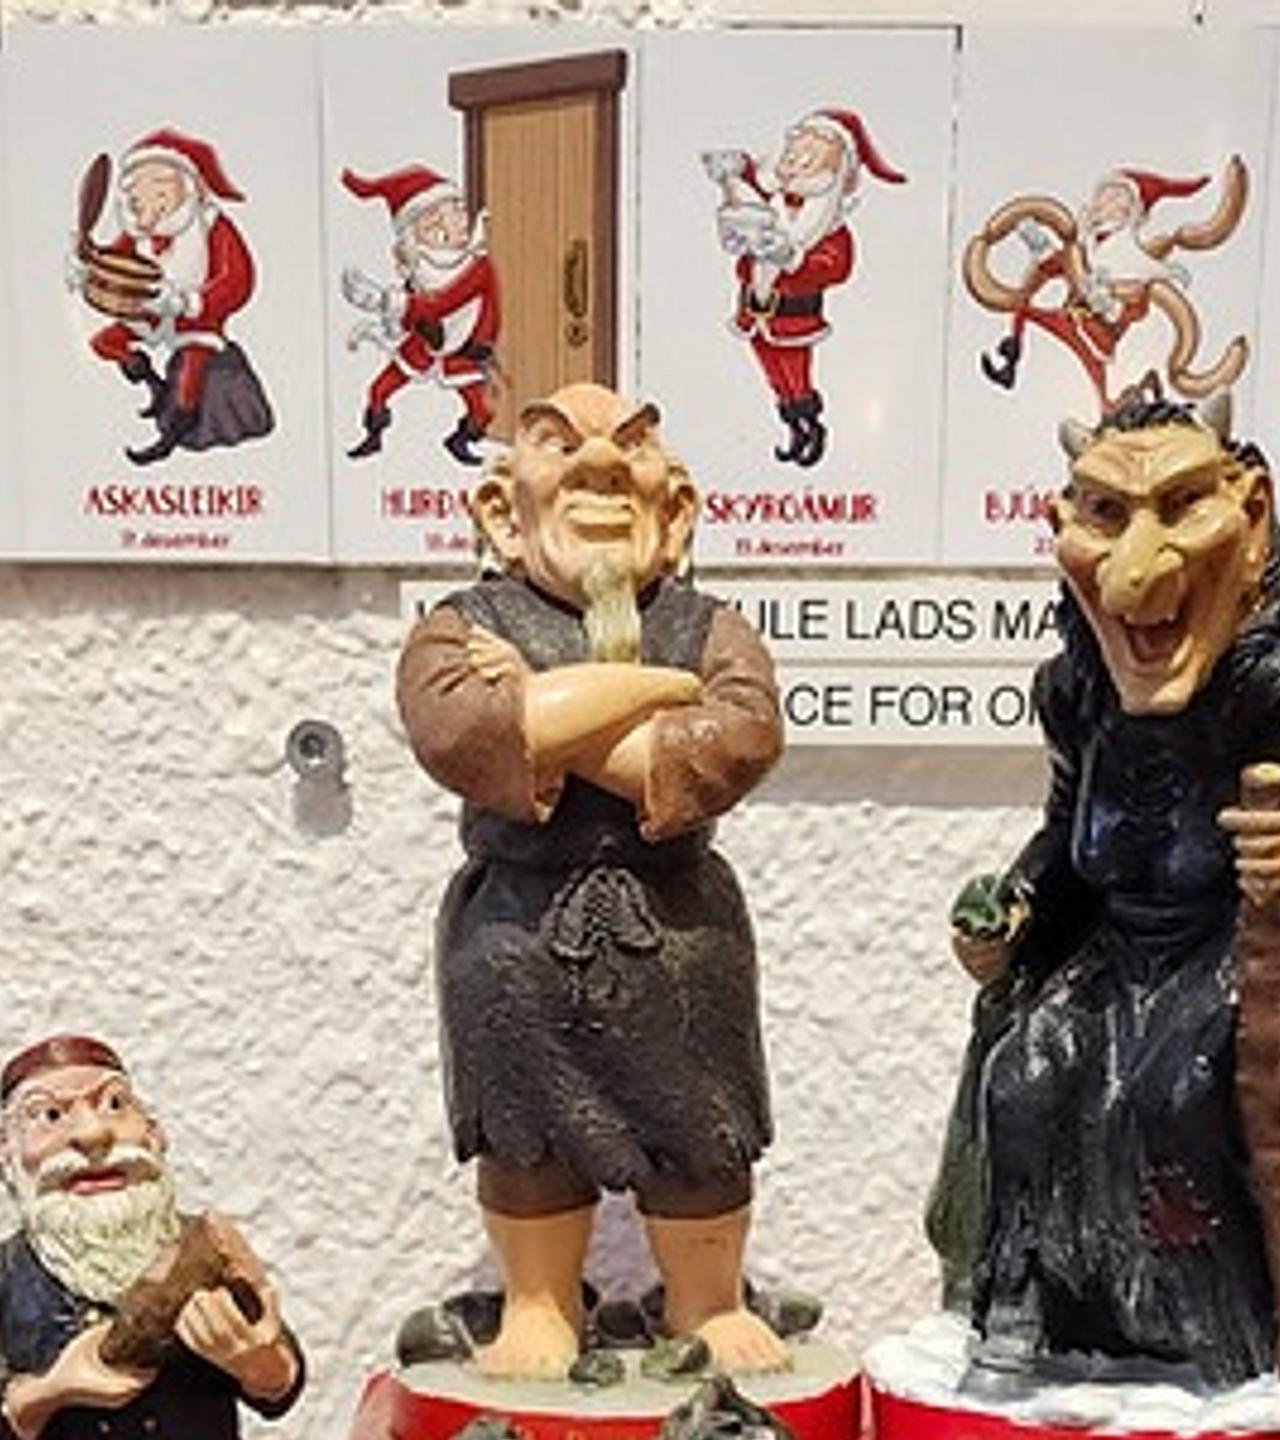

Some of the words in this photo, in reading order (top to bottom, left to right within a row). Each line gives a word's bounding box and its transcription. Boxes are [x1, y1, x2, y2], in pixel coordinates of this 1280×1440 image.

[845, 599, 976, 641] LADS
[990, 599, 1058, 641] MA
[869, 684, 973, 727] FOR
